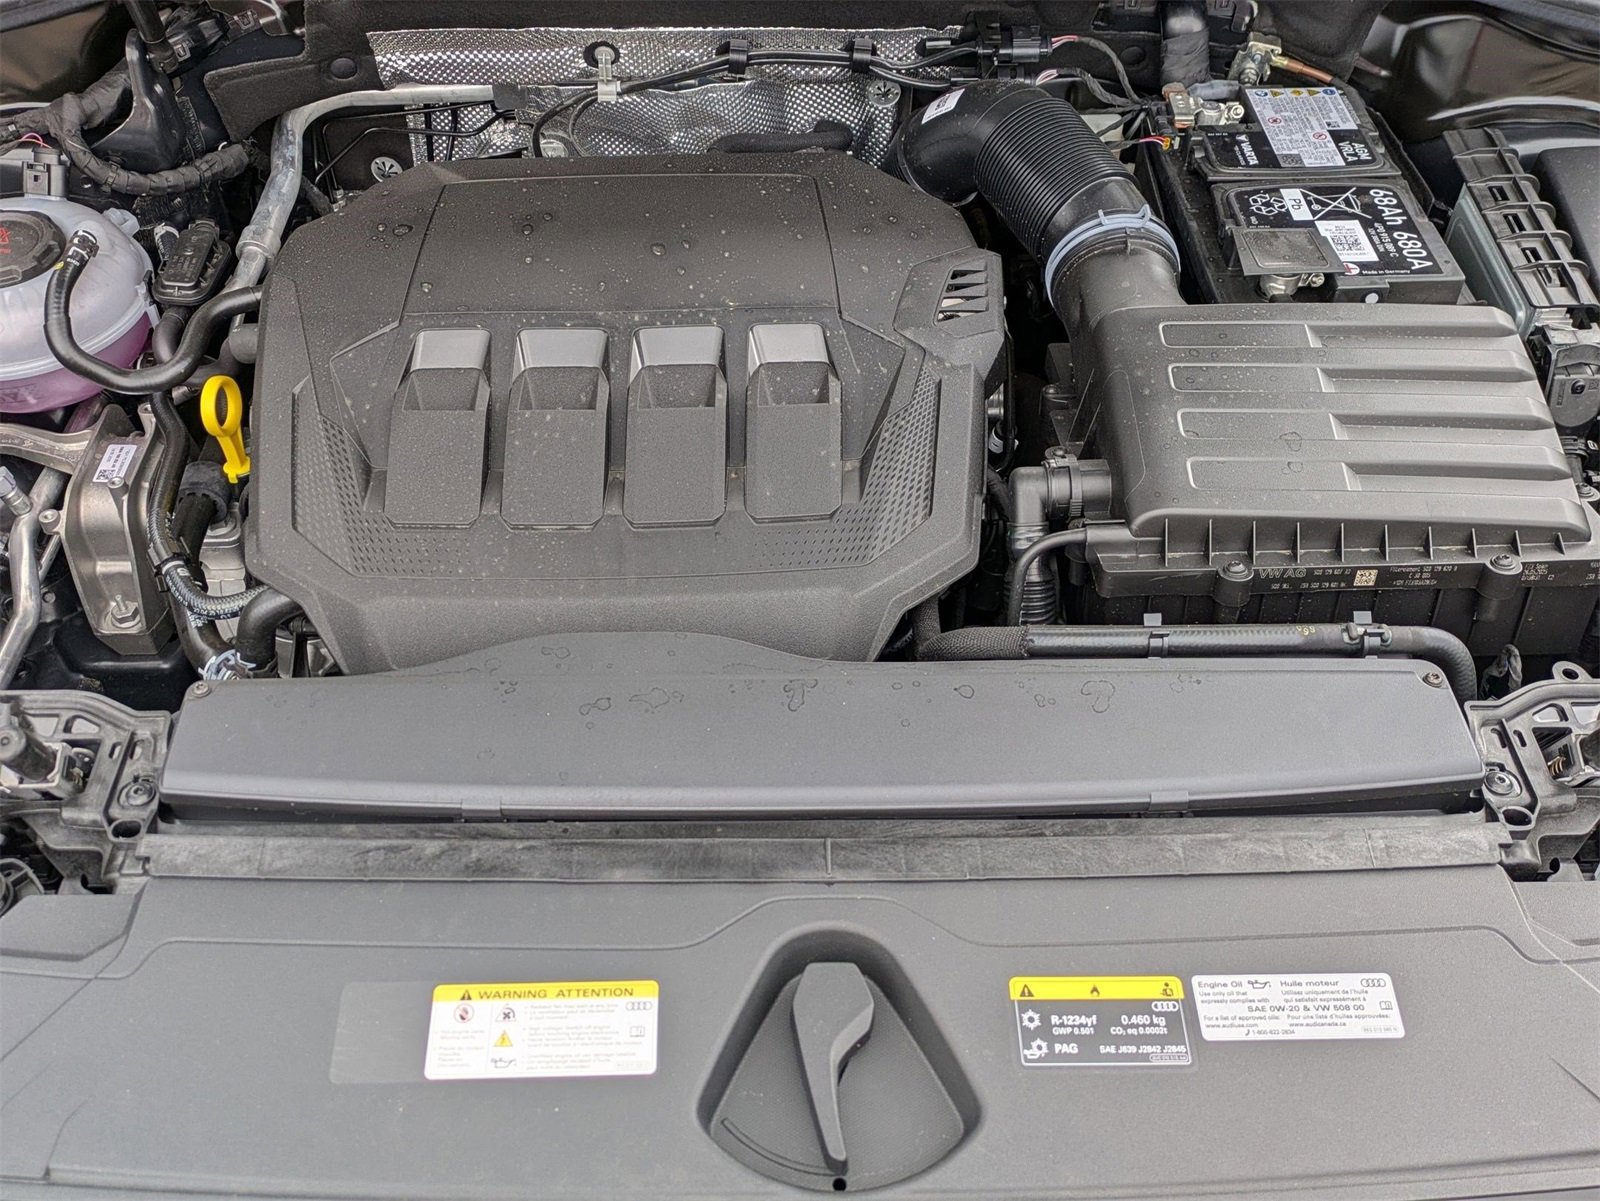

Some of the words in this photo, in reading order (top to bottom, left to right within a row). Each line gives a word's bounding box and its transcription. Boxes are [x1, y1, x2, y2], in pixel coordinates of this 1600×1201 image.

[1241, 142, 1258, 165] VARTA
[1338, 141, 1358, 162] VRLA
[1352, 142, 1372, 160] AGM
[1288, 198, 1302, 210] Pb
[1369, 188, 1408, 225] 68Ah
[1393, 232, 1433, 270] 680A
[1260, 568, 1284, 578] VW
[1284, 568, 1306, 578] AG
[1198, 980, 1228, 989] Engine
[478, 990, 547, 999] WARNING
[556, 988, 634, 998] ATTENTION
[1050, 1015, 1097, 1026] R-1234yf
[1121, 1014, 1151, 1025] 0.460
[1152, 1014, 1166, 1026] kg
[1054, 1044, 1079, 1054] PAG
